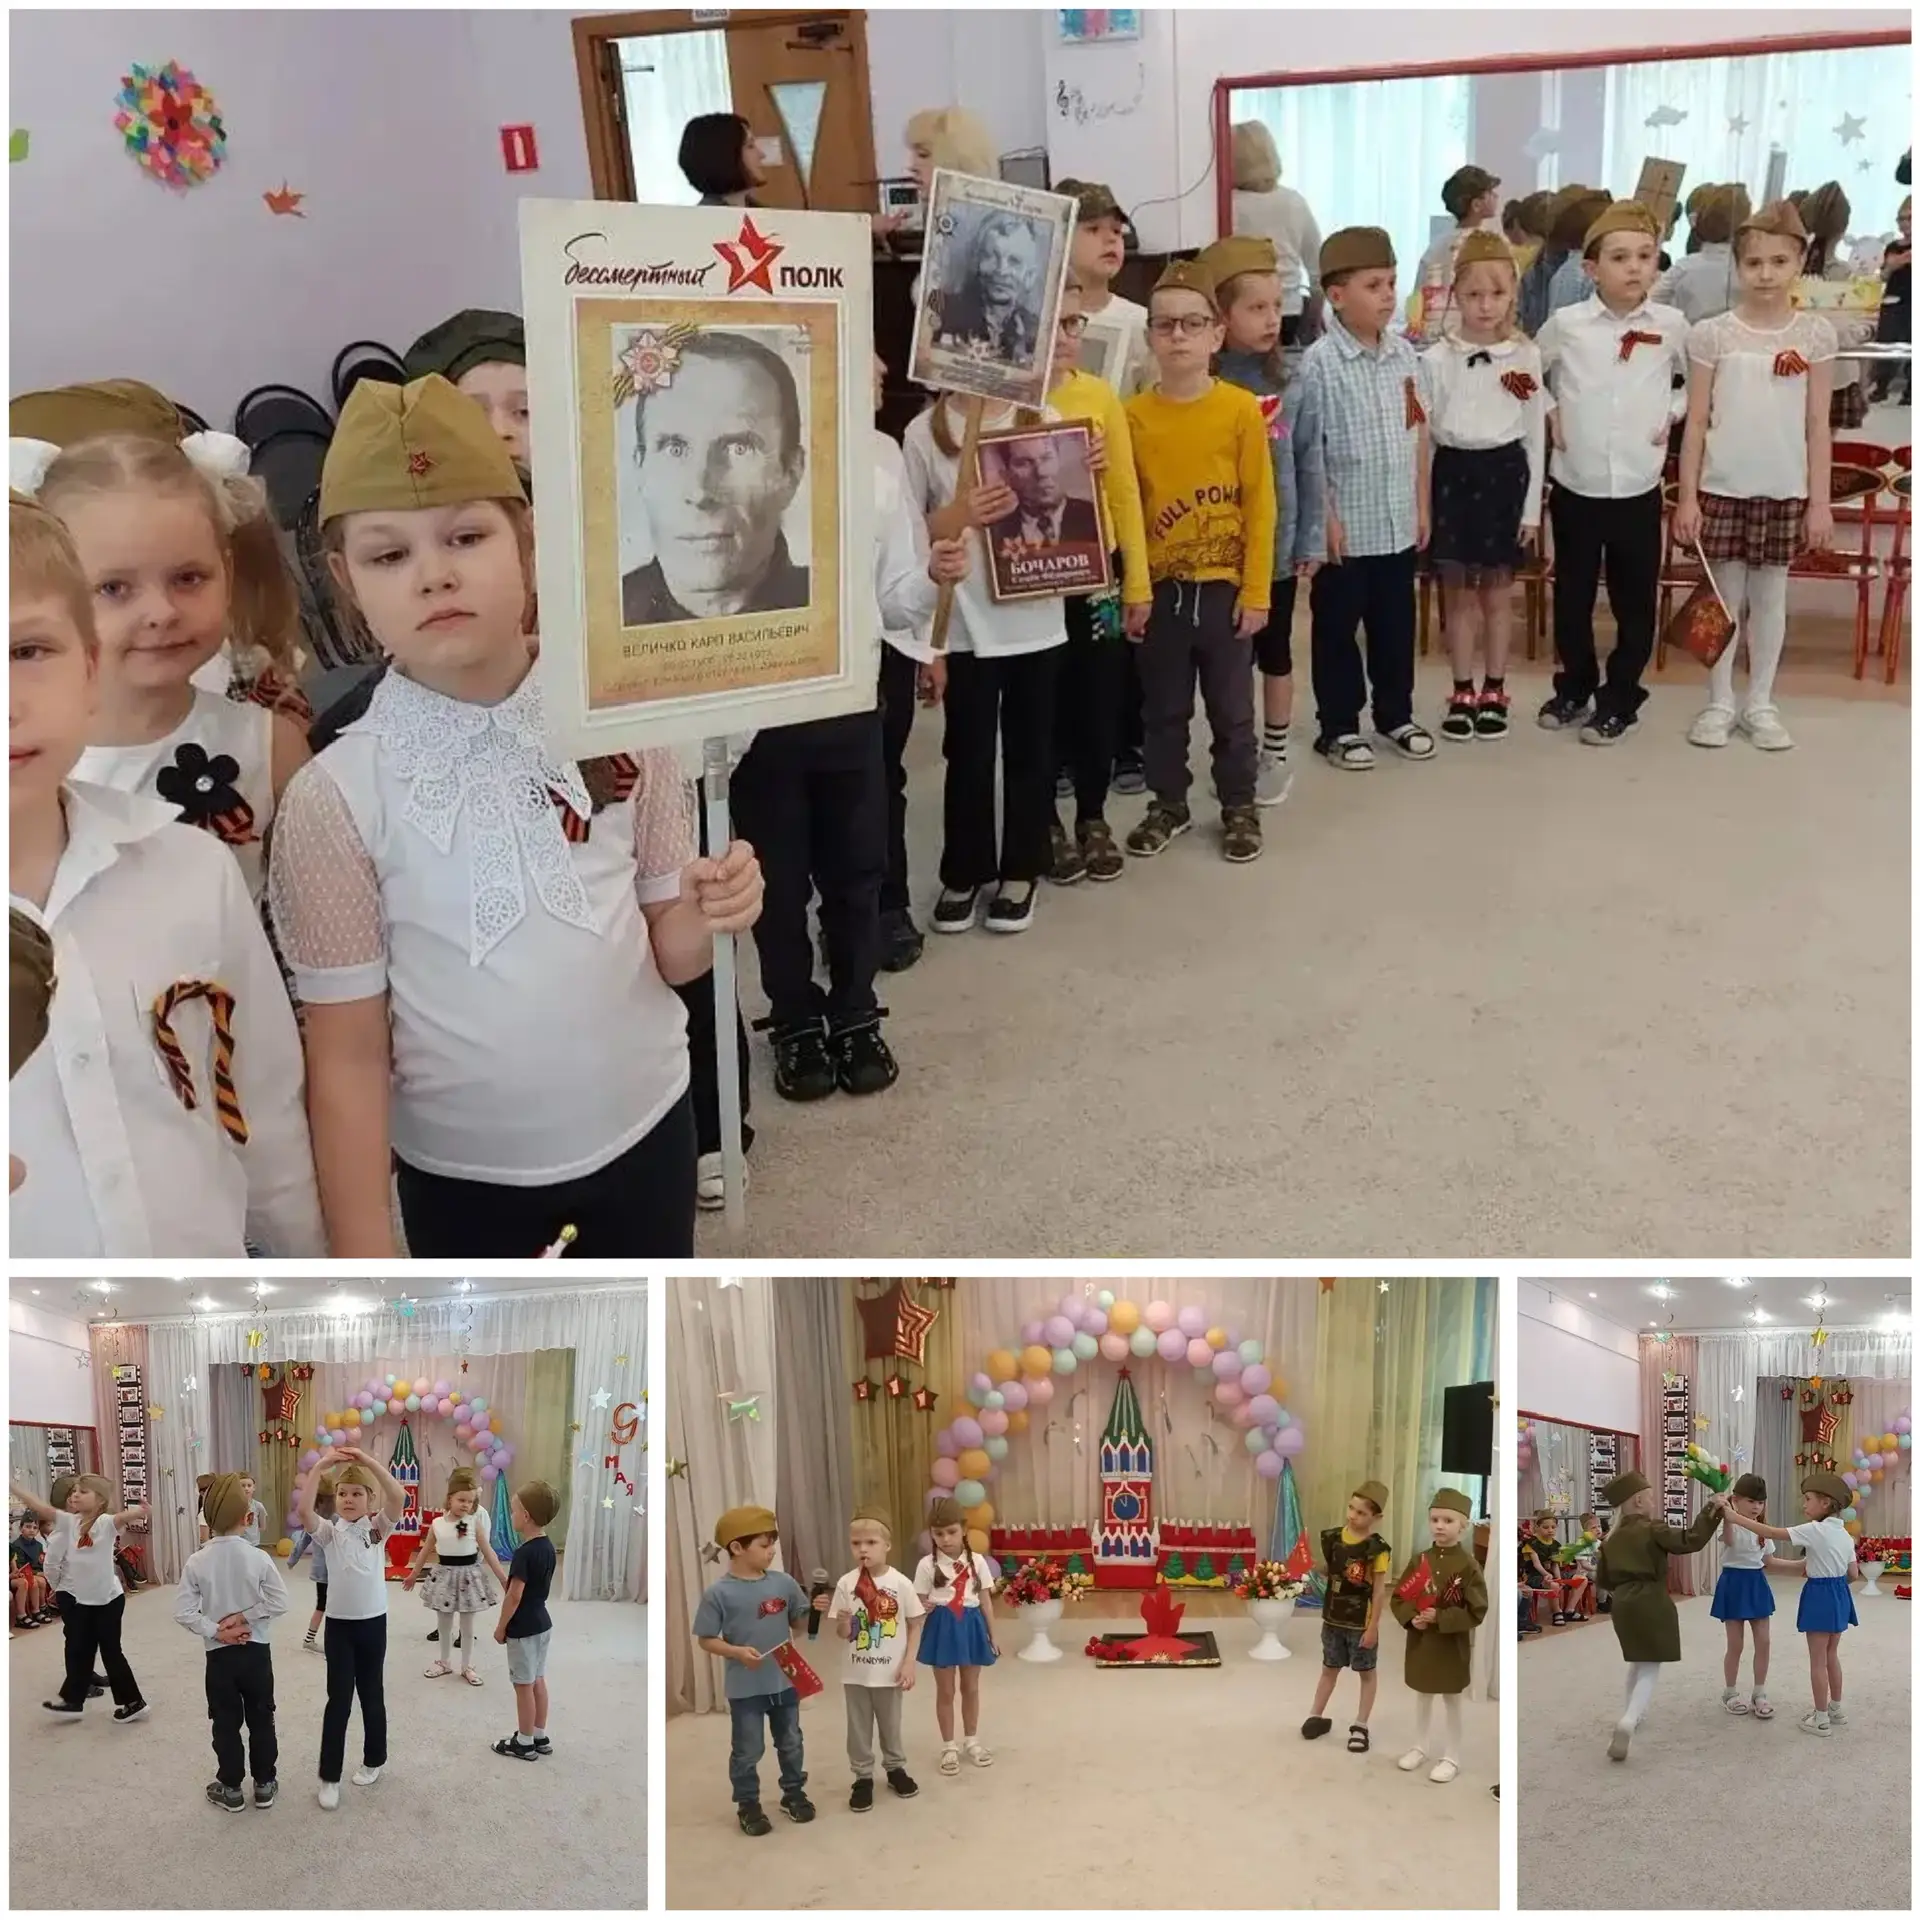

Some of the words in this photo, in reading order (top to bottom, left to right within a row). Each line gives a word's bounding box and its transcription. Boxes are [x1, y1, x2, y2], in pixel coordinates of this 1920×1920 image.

[779, 266, 844, 288] ПОЛК
[1154, 498, 1191, 540] FULL
[1195, 484, 1240, 506] POW
[1010, 554, 1089, 575] БОЧАРОВ
[623, 640, 687, 658] ВЕЛИЧКО
[690, 632, 724, 650] КАРП
[728, 623, 809, 645] ВАСИЛЬЕВИЧ
[611, 1403, 638, 1445] 9
